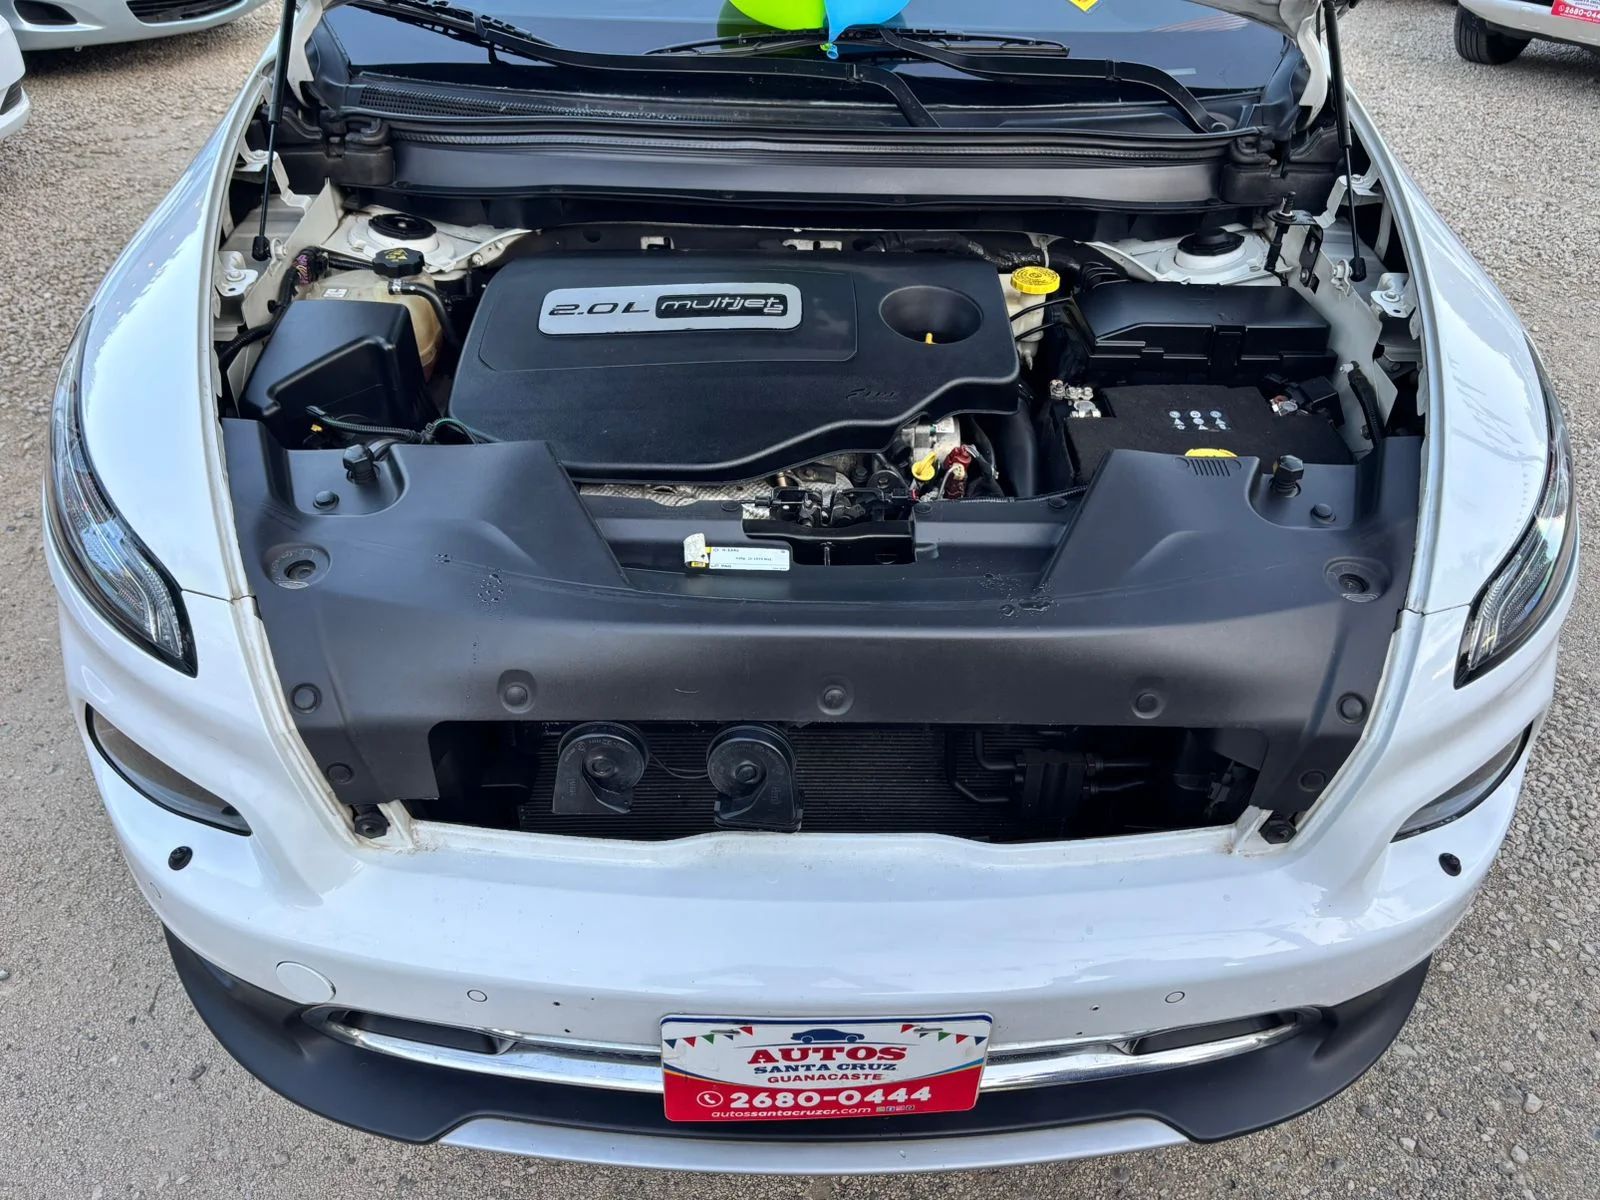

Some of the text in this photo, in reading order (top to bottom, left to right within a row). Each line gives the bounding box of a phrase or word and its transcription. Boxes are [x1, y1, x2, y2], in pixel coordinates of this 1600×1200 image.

[747, 1046, 907, 1064] AUTOS
[754, 1063, 898, 1074] SANTA CRUZ
[767, 1073, 882, 1083] GUANACASTE
[730, 1086, 932, 1108] 2680-0444
[711, 1107, 871, 1117] autossantacruzcr.com
